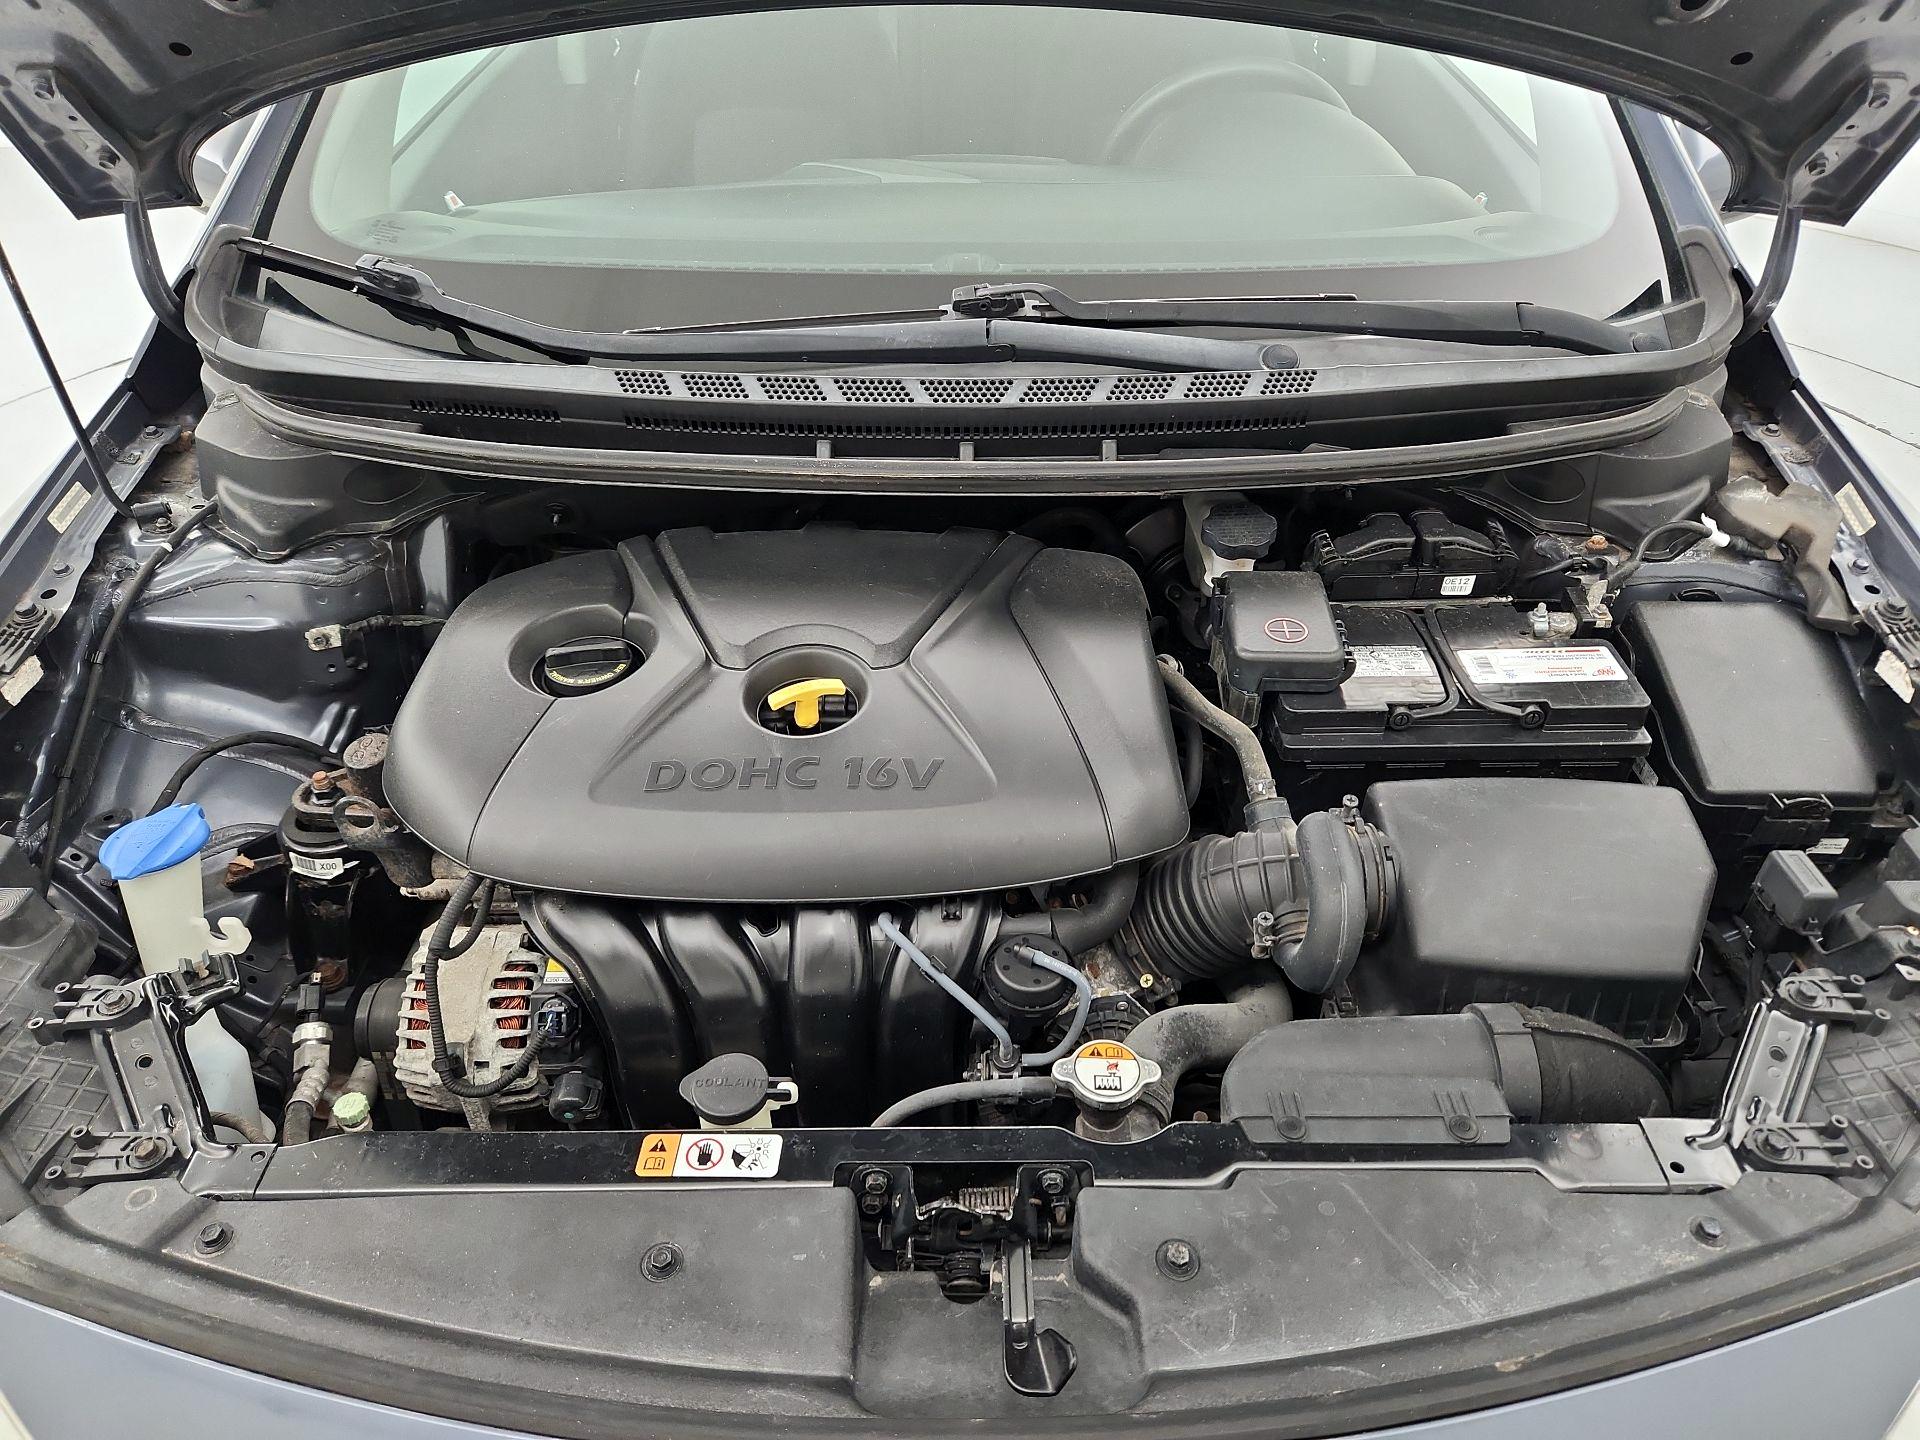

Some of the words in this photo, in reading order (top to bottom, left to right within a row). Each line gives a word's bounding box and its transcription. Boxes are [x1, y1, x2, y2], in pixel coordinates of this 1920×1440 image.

[643, 756, 820, 792] DOHC
[844, 756, 945, 790] 16V
[319, 862, 337, 871] X00
[695, 1077, 766, 1089] COOLANT
